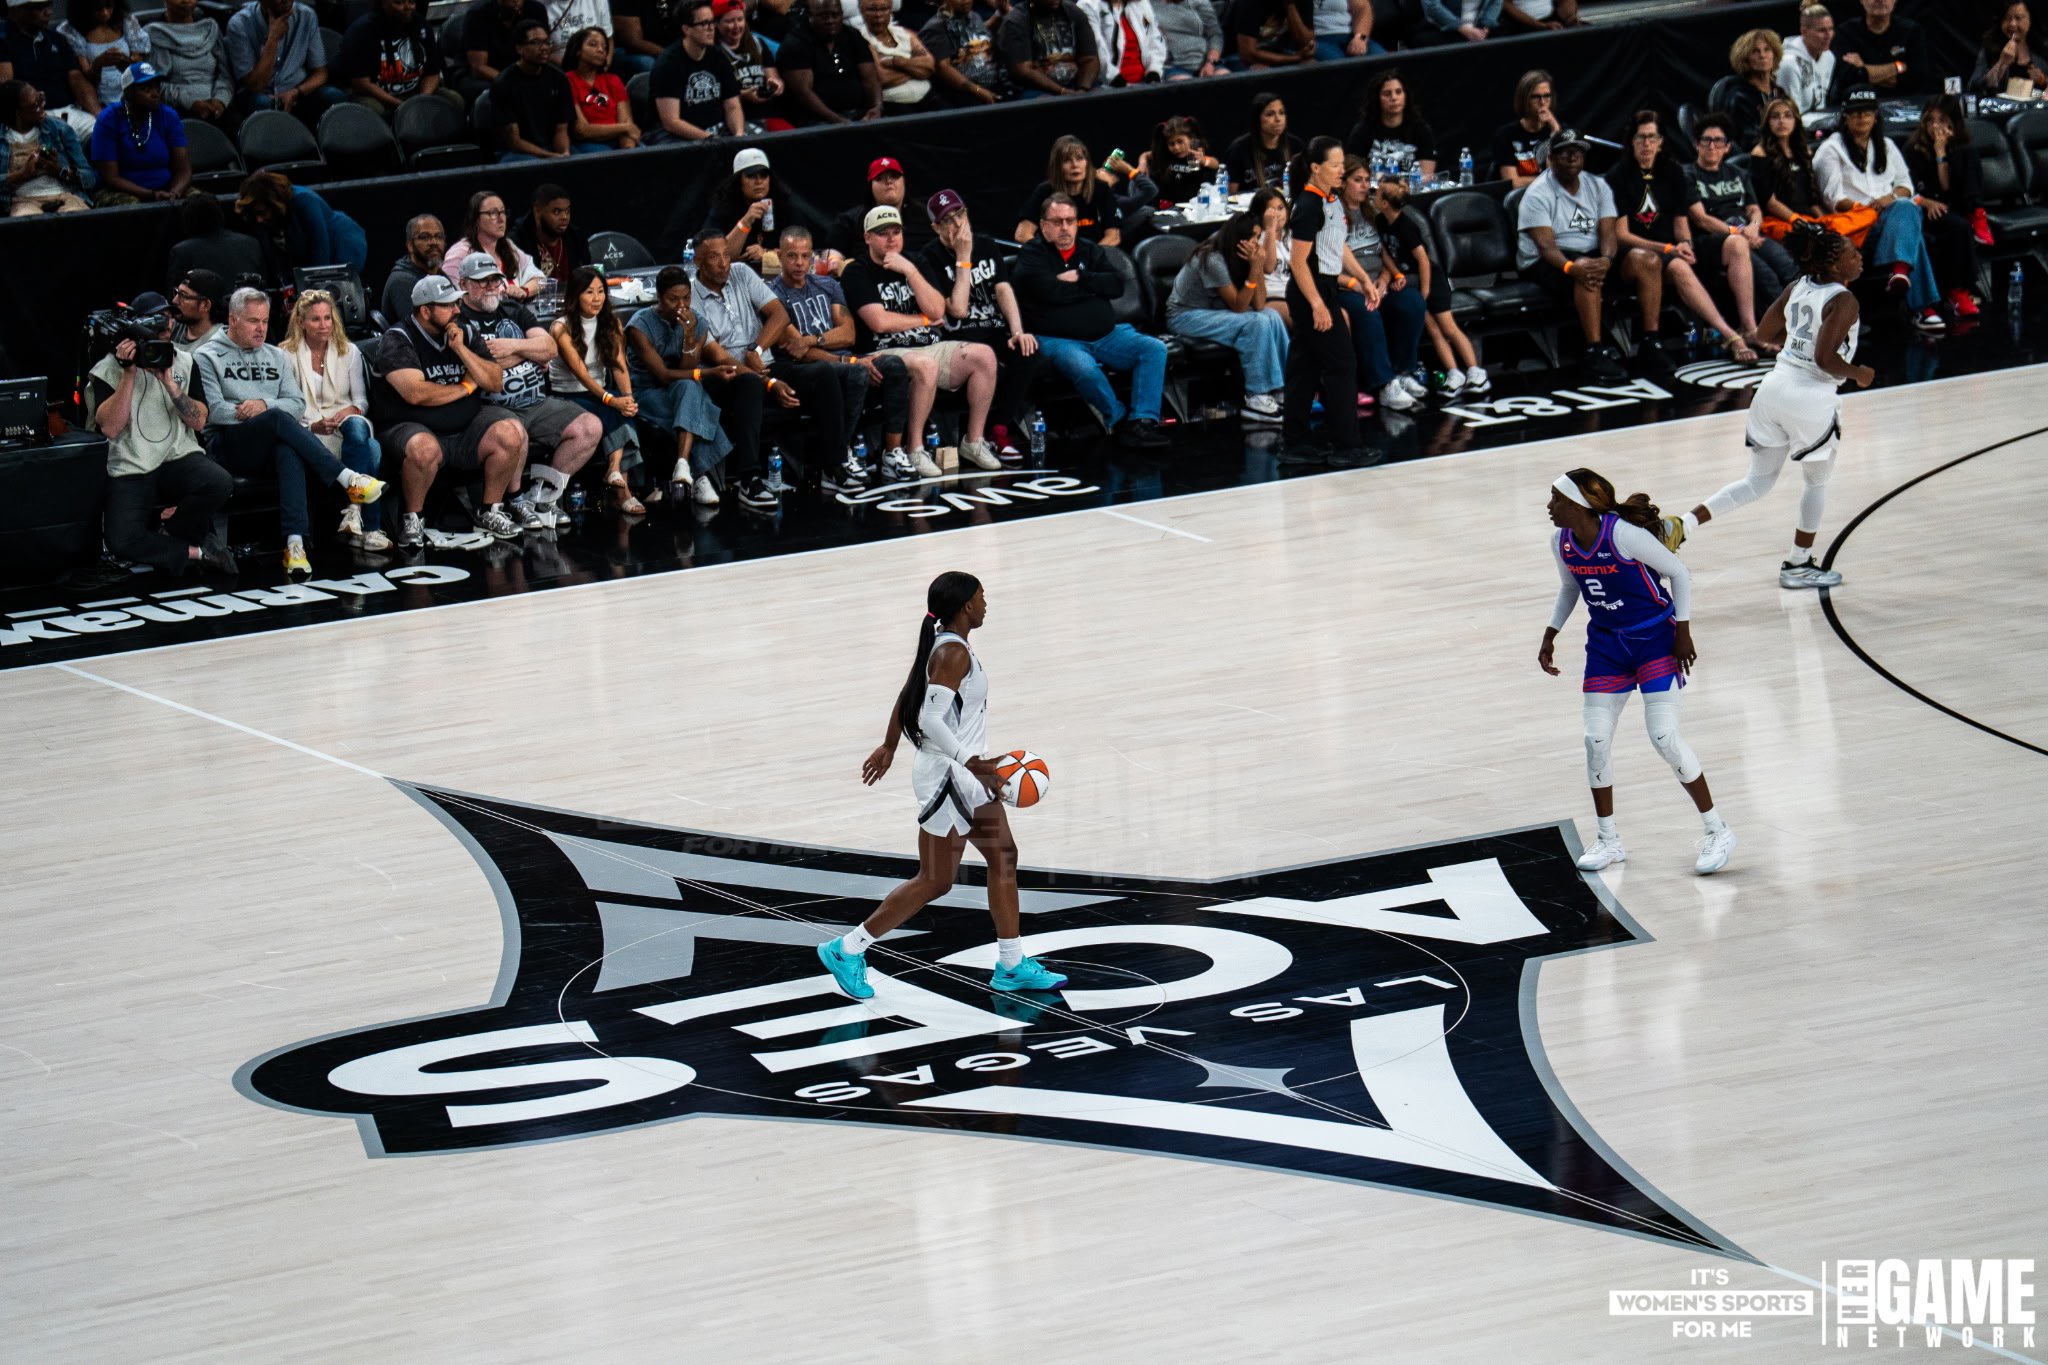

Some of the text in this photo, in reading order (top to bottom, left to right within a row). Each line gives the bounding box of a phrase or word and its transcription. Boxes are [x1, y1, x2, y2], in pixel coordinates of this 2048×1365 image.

[1849, 91, 1876, 100] ACES
[877, 212, 898, 220] ACES
[1790, 302, 1813, 340] 12
[224, 367, 280, 381] ACES
[426, 365, 444, 379] LAS
[1441, 377, 1674, 428] AT&T
[1585, 578, 1606, 597] 2
[795, 975, 1458, 1104] LAS VEGAS
